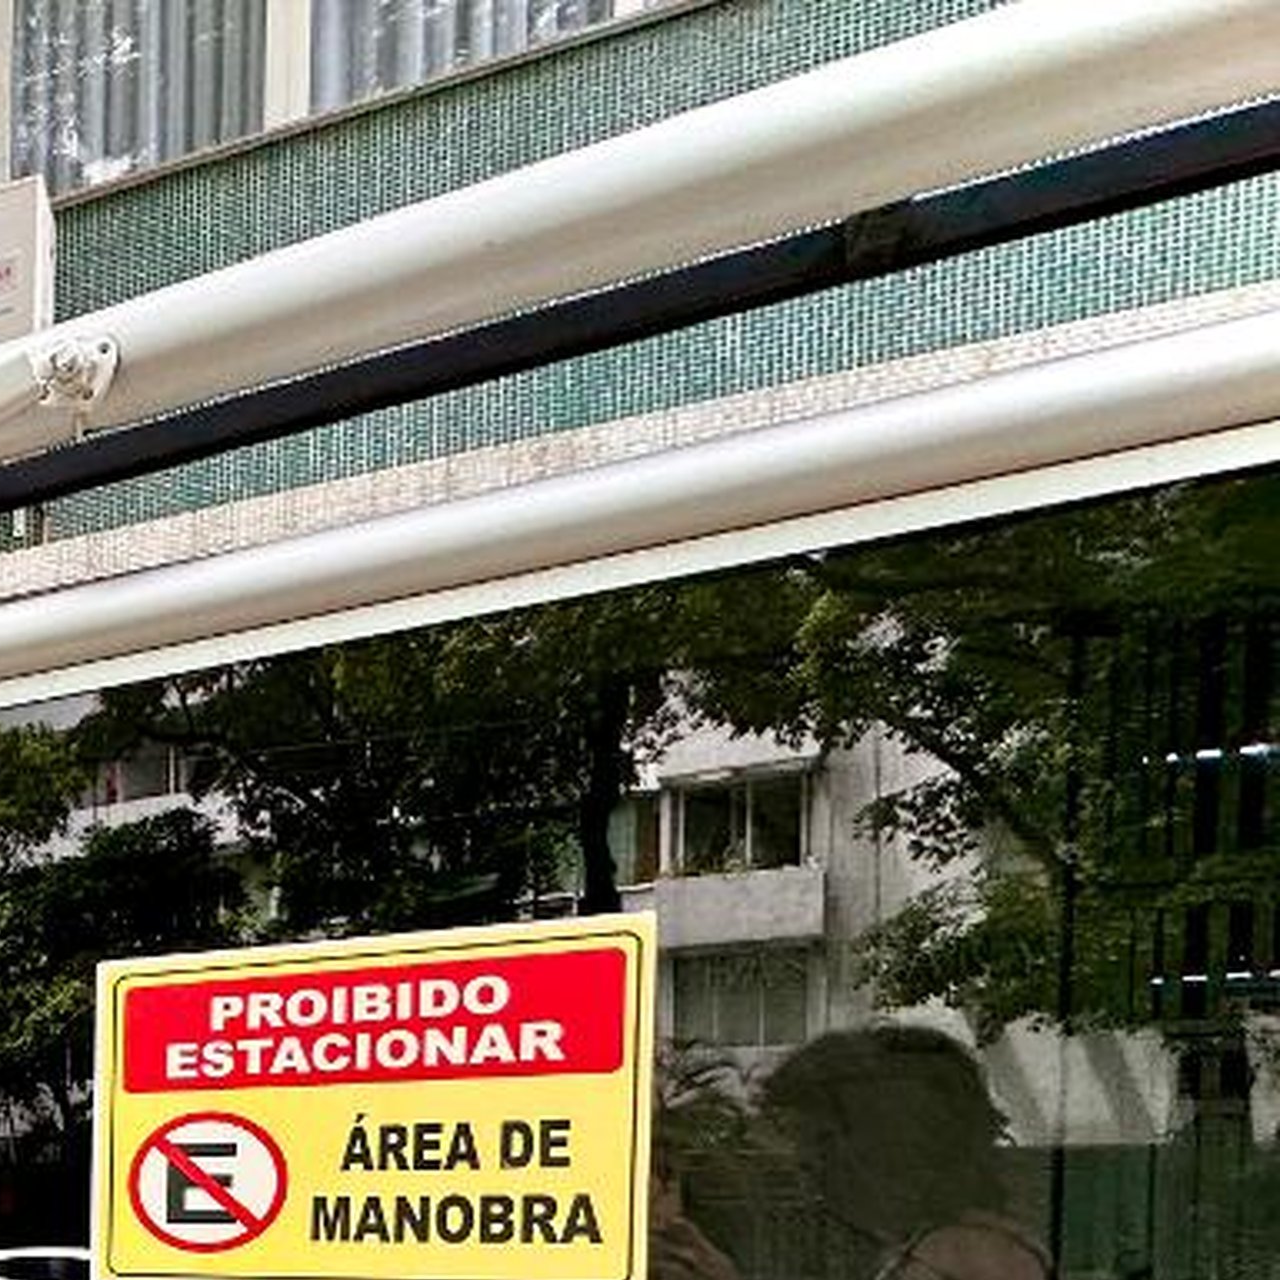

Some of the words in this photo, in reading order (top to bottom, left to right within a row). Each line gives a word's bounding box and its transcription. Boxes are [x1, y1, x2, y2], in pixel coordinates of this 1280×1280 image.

[209, 975, 511, 1031] PROIBIDO
[165, 1021, 565, 1080] ESTACIONAR
[341, 1114, 480, 1172] ÁREA
[499, 1119, 571, 1169] DE
[309, 1193, 602, 1244] MANOBRA
